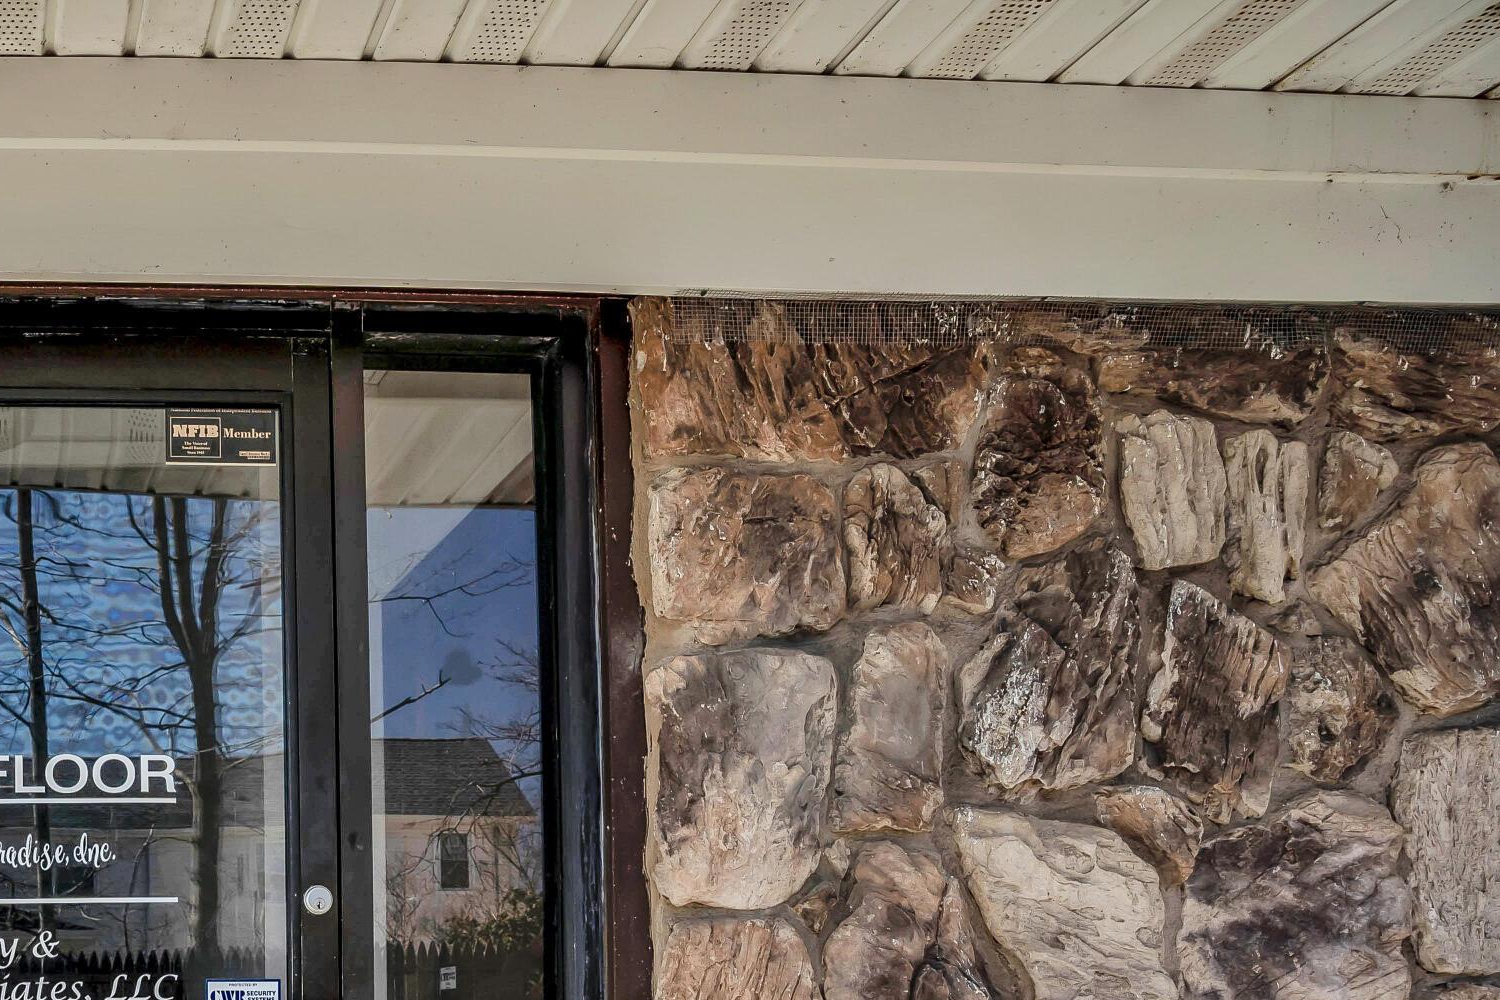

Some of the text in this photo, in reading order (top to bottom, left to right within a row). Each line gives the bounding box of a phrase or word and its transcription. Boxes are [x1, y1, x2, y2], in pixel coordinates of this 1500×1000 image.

[172, 424, 219, 438] NFIB
[223, 428, 271, 439] Member
[73, 832, 116, 868] Inc.
[31, 930, 60, 958] &
